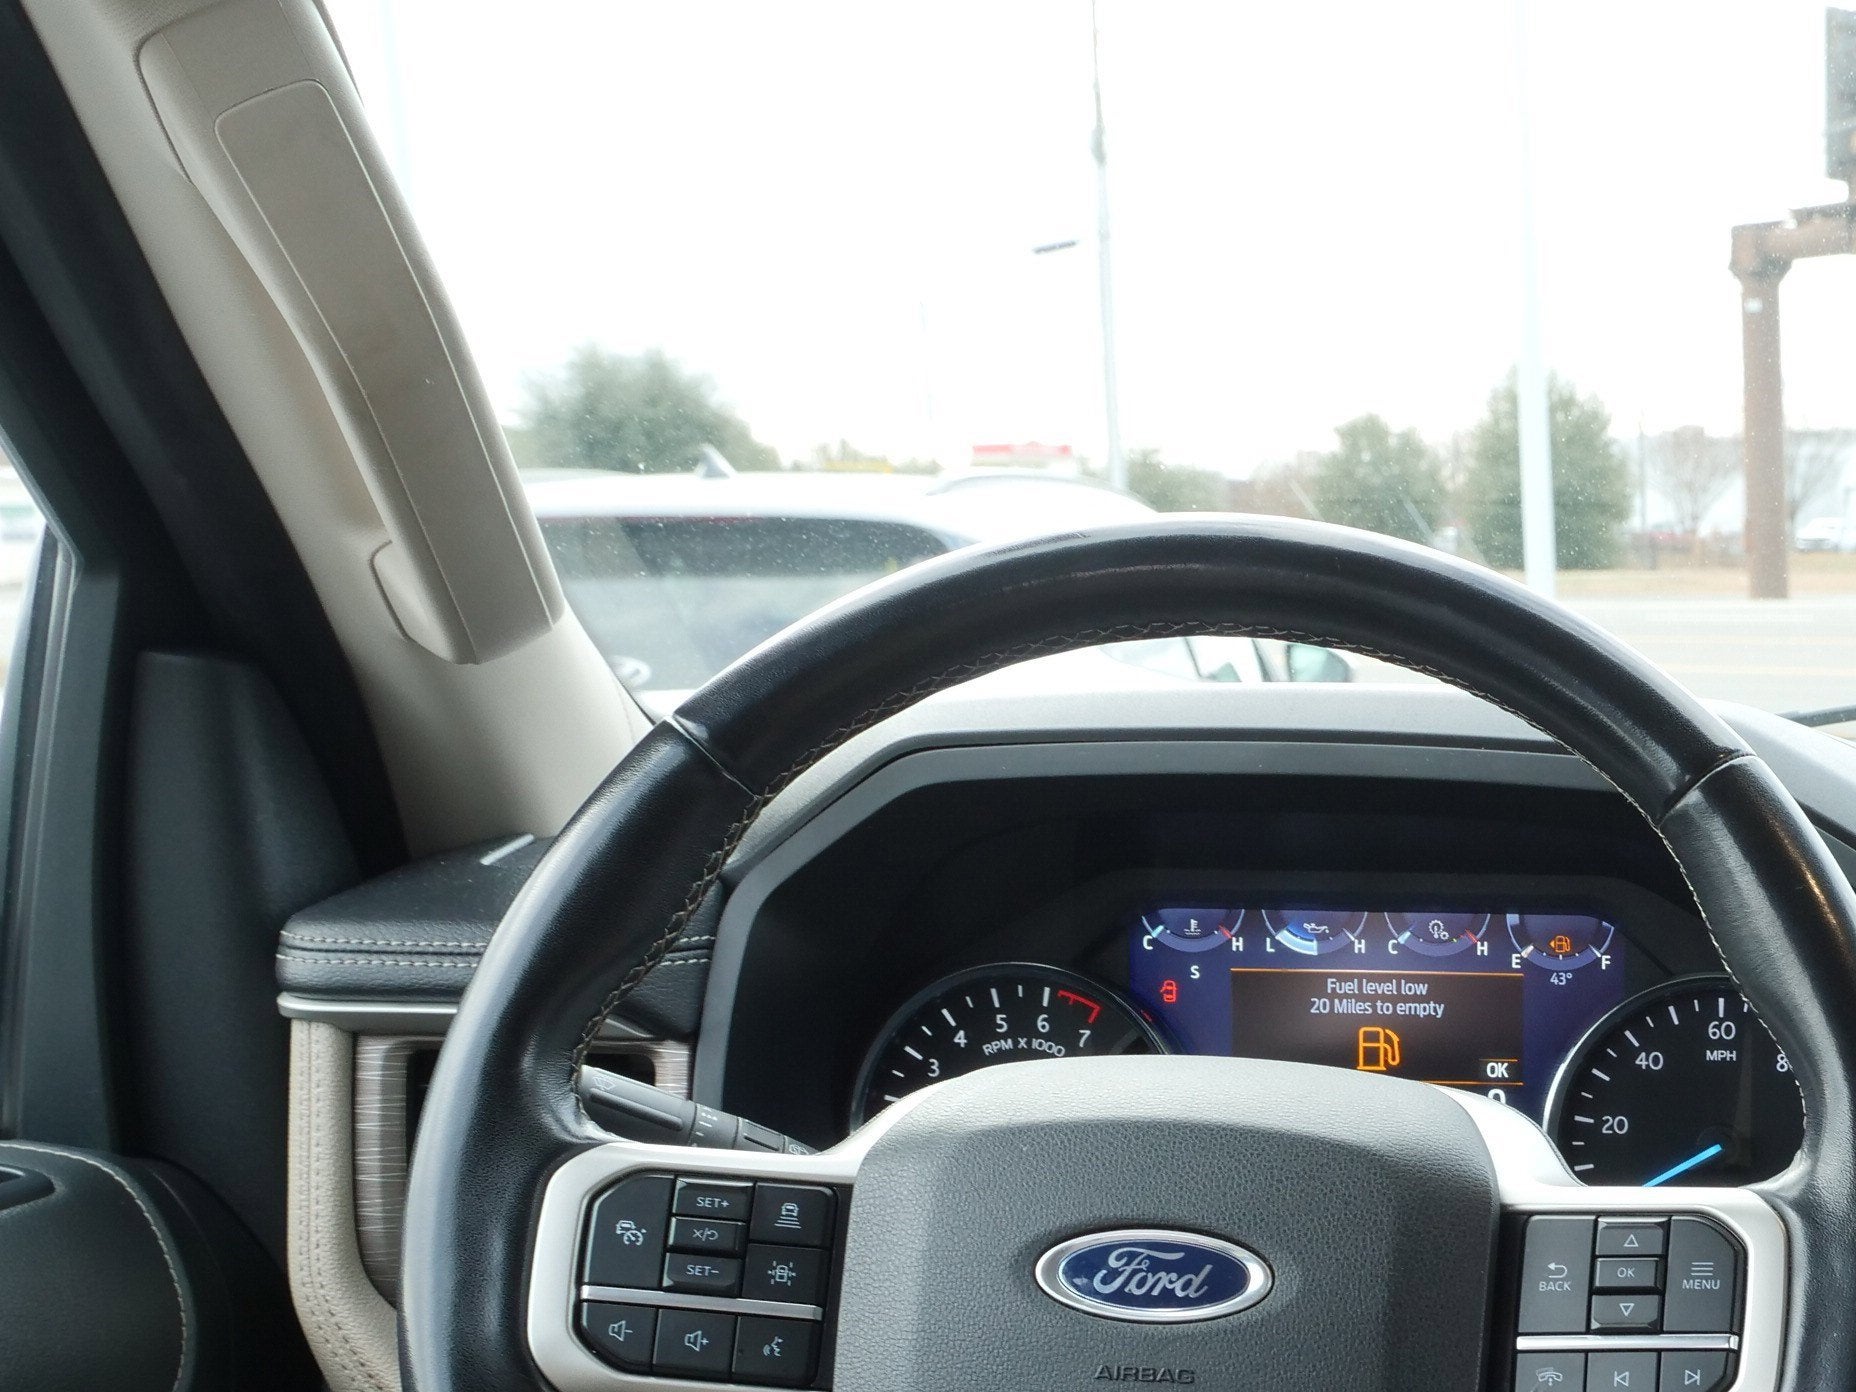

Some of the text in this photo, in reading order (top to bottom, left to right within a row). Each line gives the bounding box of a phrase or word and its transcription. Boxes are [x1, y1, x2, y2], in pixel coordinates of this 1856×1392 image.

[1143, 936, 1154, 951] C
[1232, 937, 1244, 952] H
[1266, 939, 1275, 953] L
[1355, 939, 1366, 953] H
[1387, 940, 1399, 955] C
[1477, 941, 1488, 956] H
[1512, 954, 1522, 969] E
[1601, 955, 1611, 971] F
[1190, 966, 1200, 979] S
[1550, 972, 1573, 986] 43°
[1327, 980, 1428, 996] Fuel level low
[1310, 1000, 1445, 1019] 20 Miles to empty
[996, 1015, 1008, 1033] 5
[1037, 1015, 1050, 1033] 6
[1708, 1021, 1736, 1040] 60
[953, 1030, 968, 1048] 4
[1079, 1029, 1091, 1047] 7
[982, 1037, 1066, 1057] RPM X 1000
[1635, 1051, 1664, 1070] 40
[1705, 1050, 1737, 1062] MPH
[927, 1059, 940, 1077] 3
[1486, 1062, 1509, 1079] OK
[1601, 1115, 1629, 1135] 20
[696, 1196, 731, 1209] SET+
[1093, 1246, 1213, 1299] Ford
[1616, 1267, 1636, 1279] OK
[1538, 1280, 1572, 1292] BACK
[1682, 1279, 1721, 1290] MENU
[1094, 1364, 1196, 1385] AIRBAG
